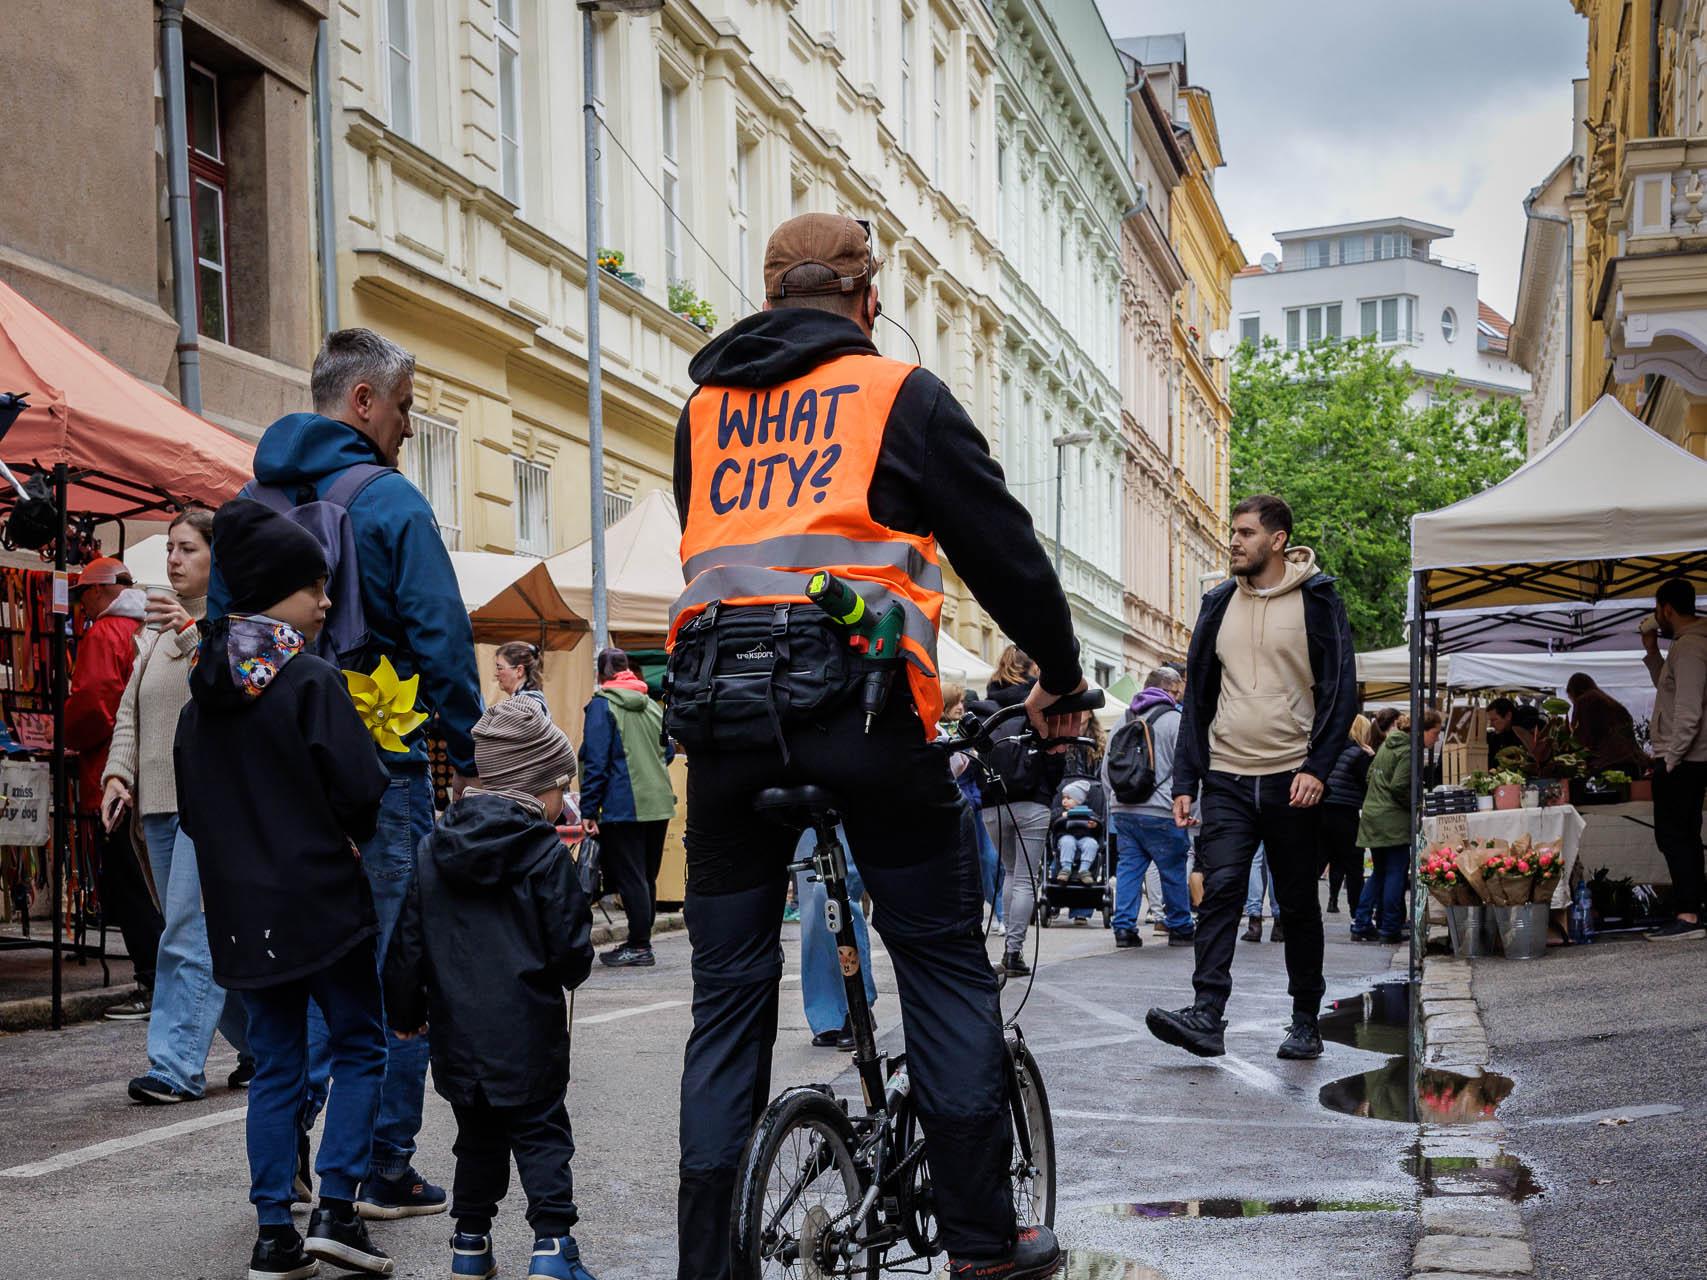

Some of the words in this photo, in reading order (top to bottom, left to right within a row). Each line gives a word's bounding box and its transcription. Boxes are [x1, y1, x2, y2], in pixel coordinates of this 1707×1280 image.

[718, 384, 860, 450] WHAT
[710, 443, 843, 516] CITY?
[736, 651, 774, 660] treksport
[12, 785, 33, 798] miss
[22, 804, 38, 822] dog
